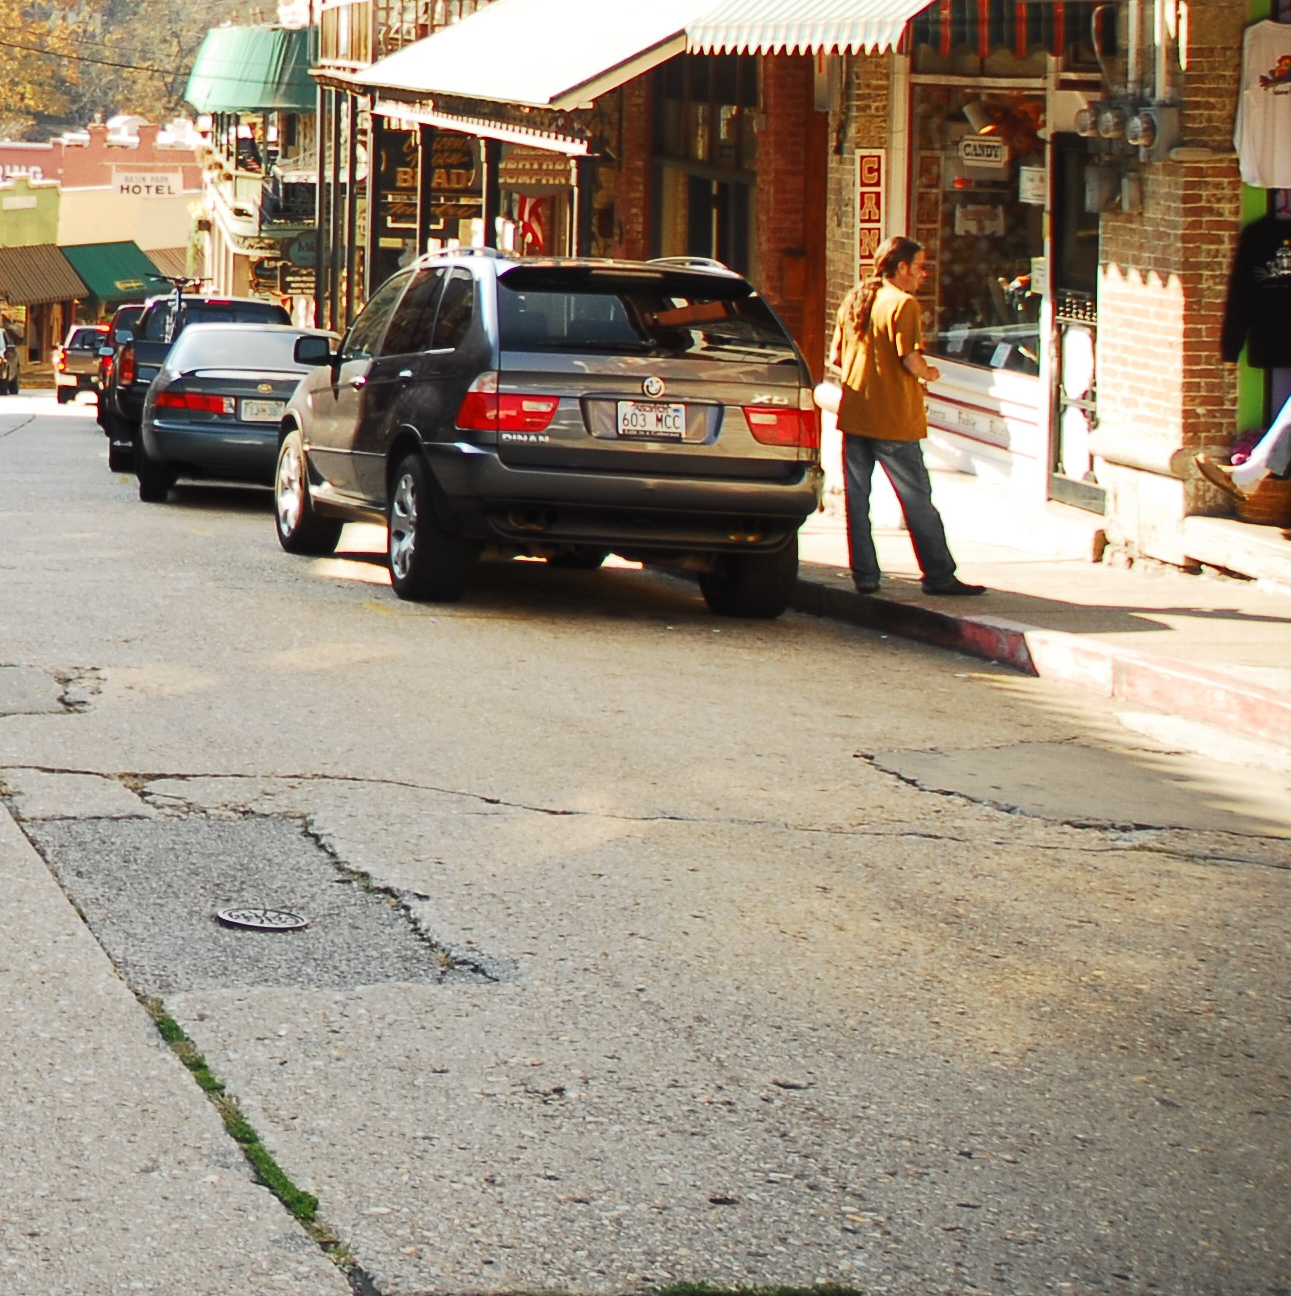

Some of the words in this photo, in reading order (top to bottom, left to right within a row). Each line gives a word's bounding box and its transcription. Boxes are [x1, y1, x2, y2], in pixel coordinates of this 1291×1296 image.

[963, 142, 1002, 159] CANDY
[120, 184, 175, 195] HOTEL
[622, 413, 647, 427] 603
[655, 414, 681, 429] MCC
